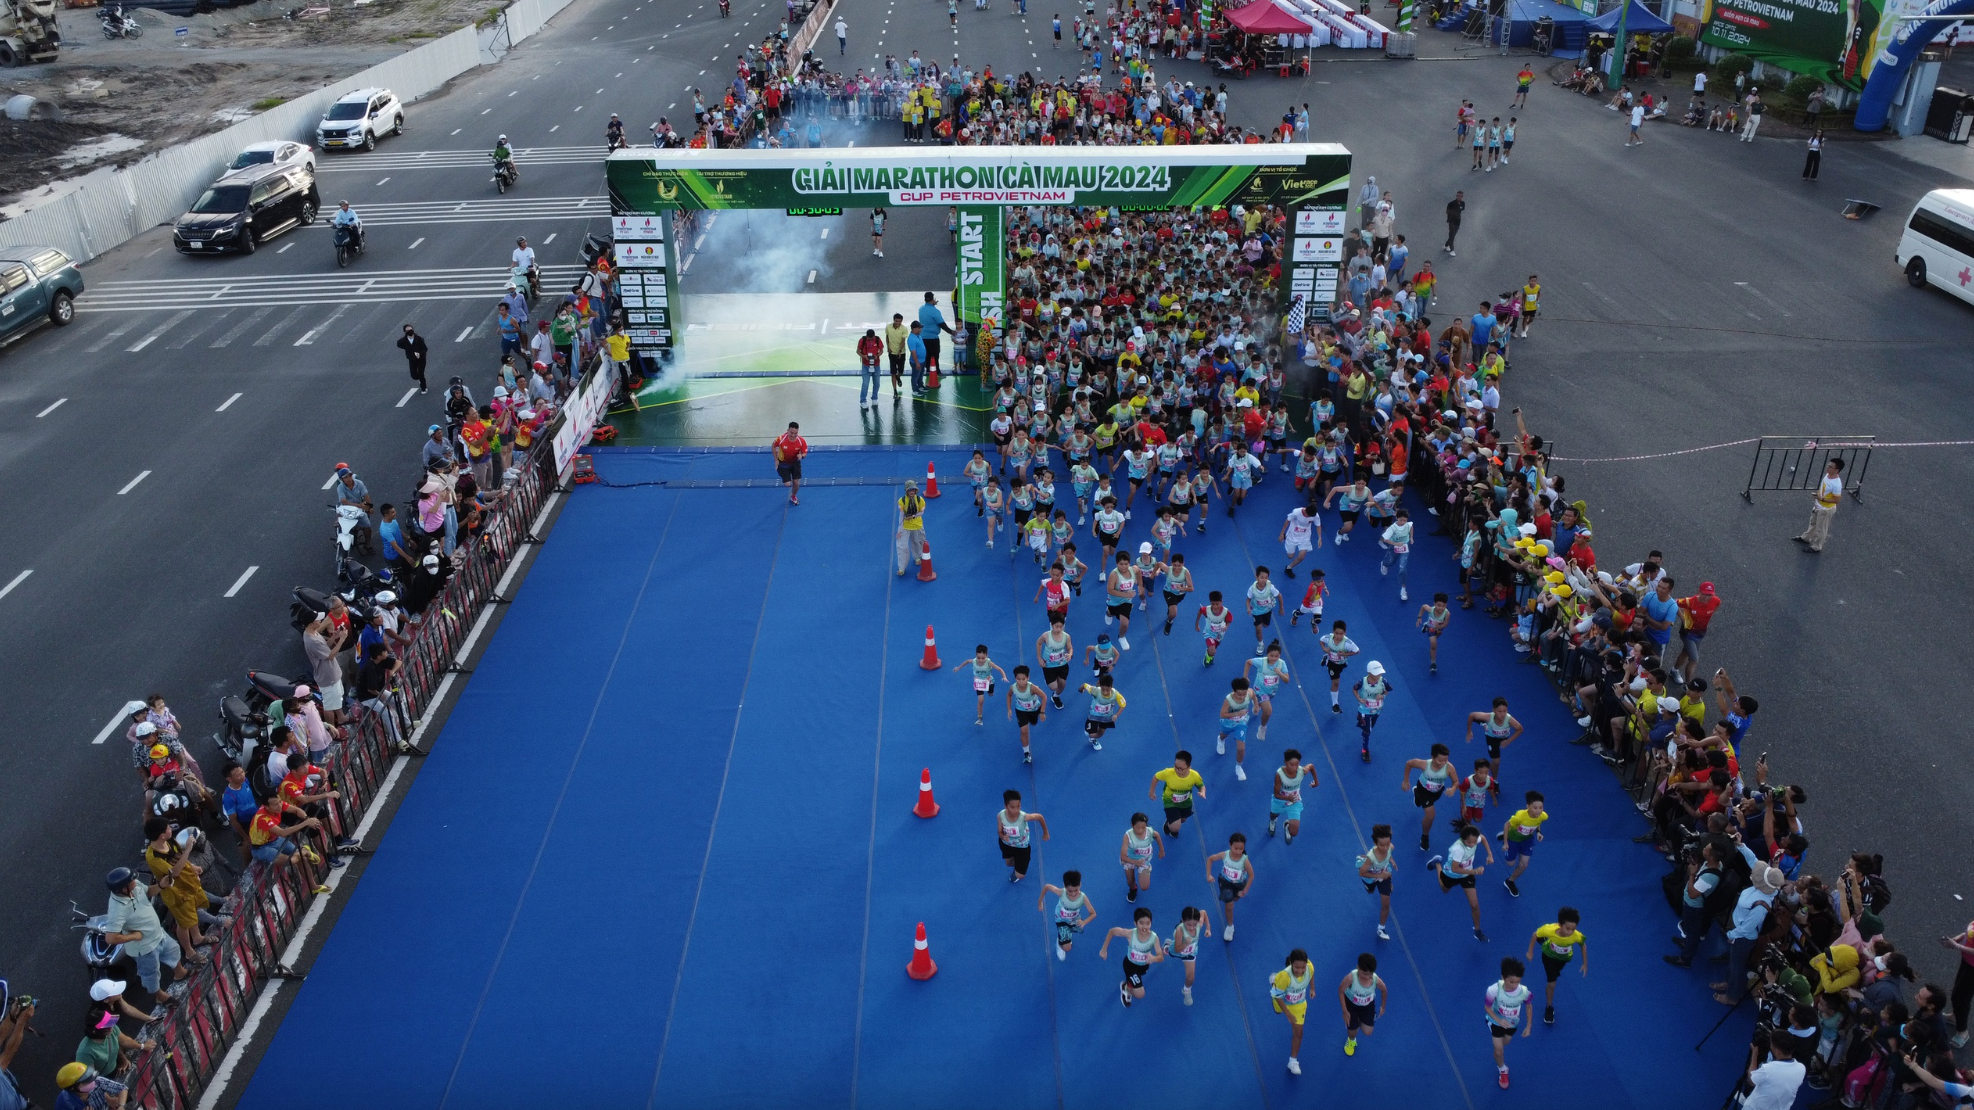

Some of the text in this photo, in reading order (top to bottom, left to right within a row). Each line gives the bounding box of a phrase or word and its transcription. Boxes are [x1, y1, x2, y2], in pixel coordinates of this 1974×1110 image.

[1711, 26, 1751, 46] 10.11.2024
[795, 161, 1168, 191] GIẢI MARATHON CÀ MAU 2024
[900, 191, 1066, 202] CUP PETROVIETNAM
[961, 211, 984, 285] START
[1129, 973, 1141, 986] 16
